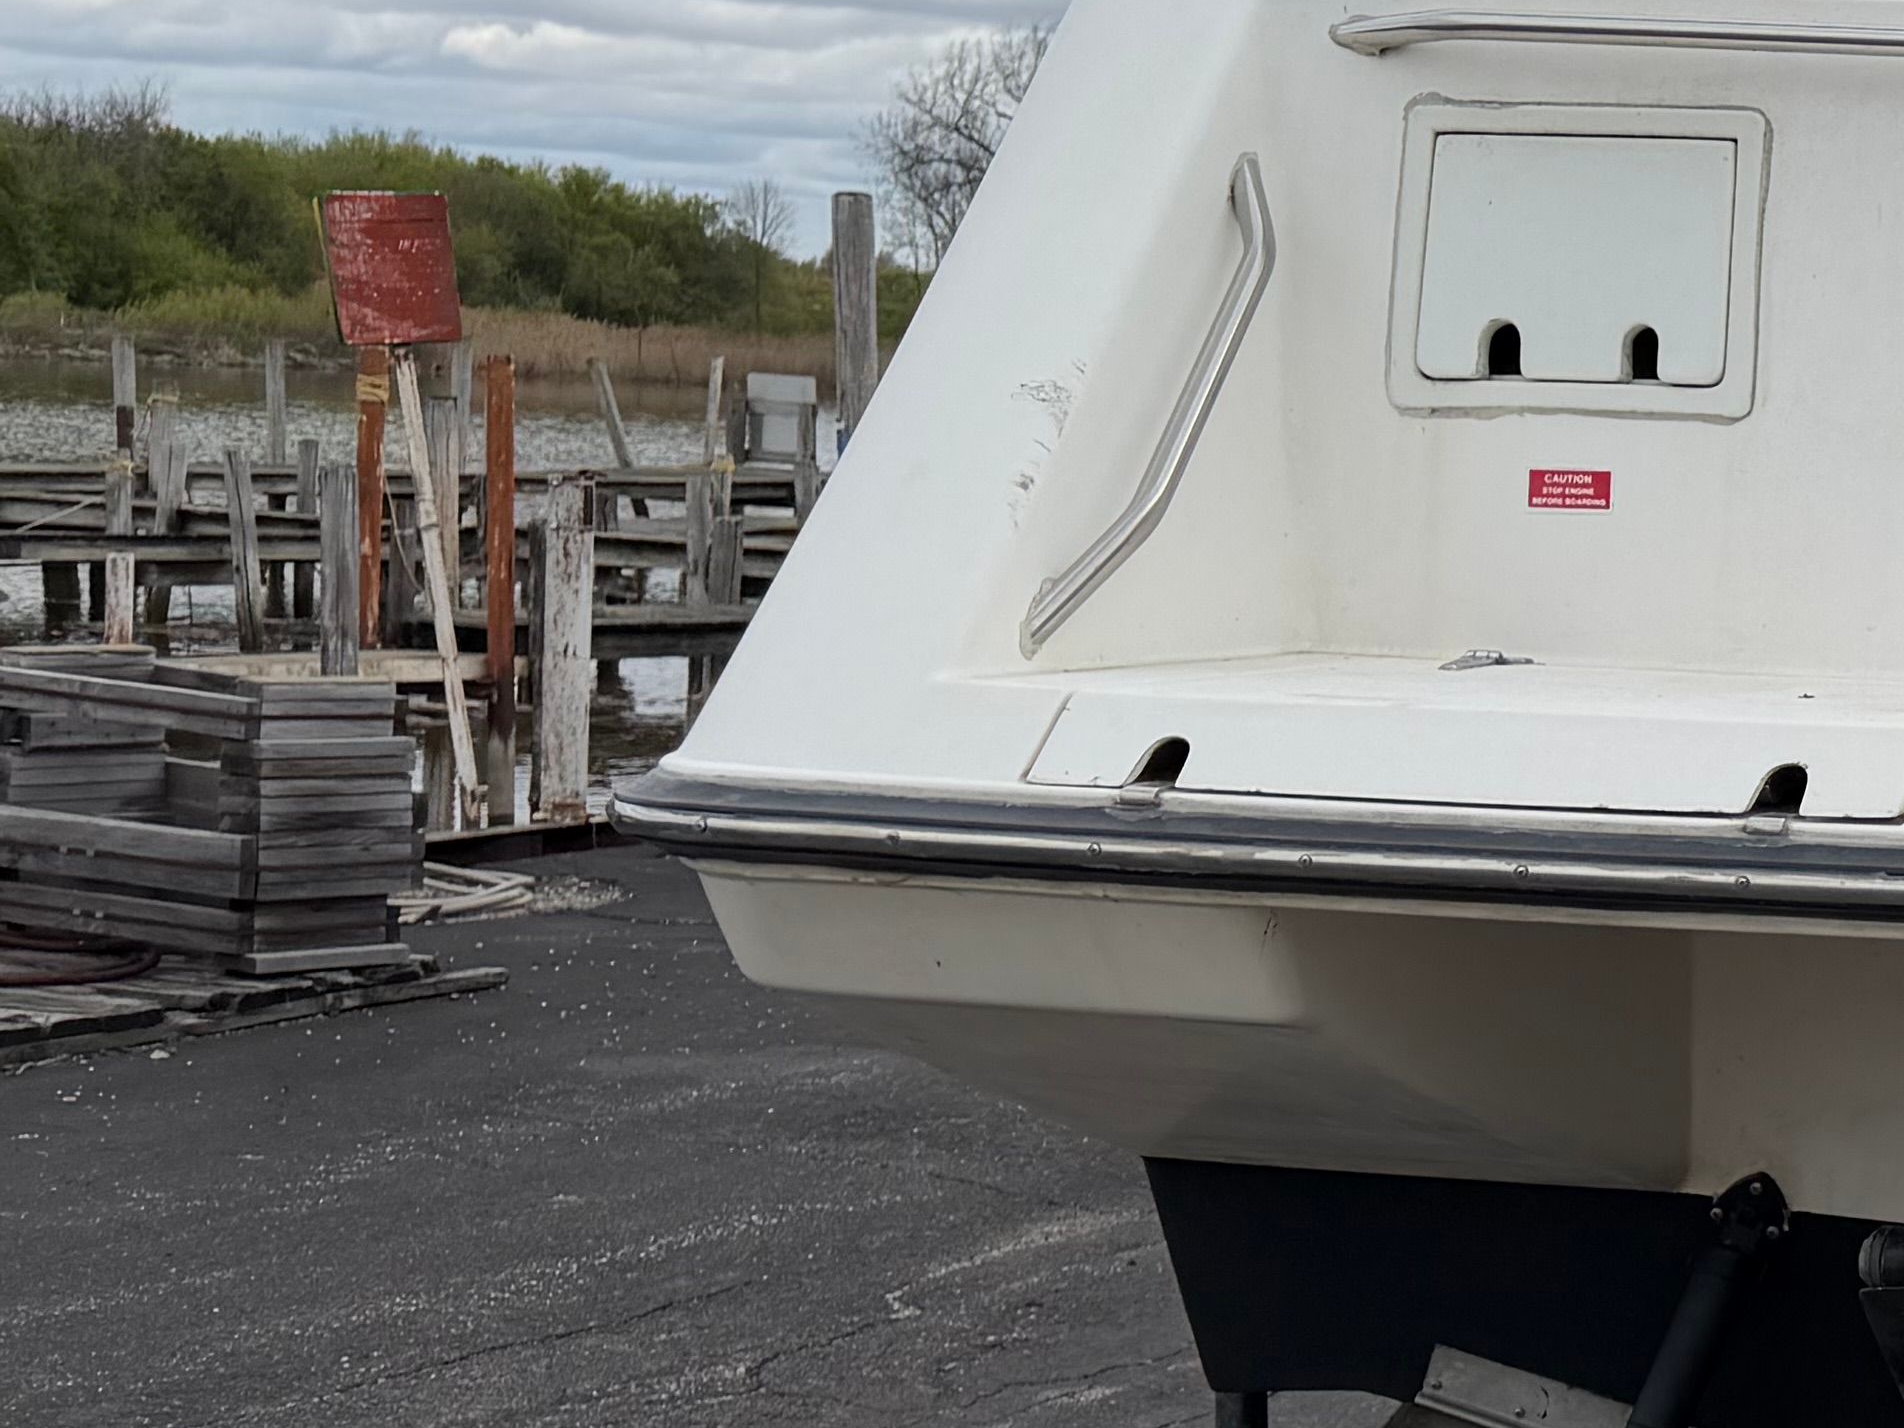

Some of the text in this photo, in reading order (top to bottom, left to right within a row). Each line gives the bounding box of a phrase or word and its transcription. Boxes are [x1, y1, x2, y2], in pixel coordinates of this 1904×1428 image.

[1544, 473, 1592, 484] CAUTION
[1542, 486, 1594, 495] STOP ENGINE
[1532, 496, 1607, 506] BEFORE BOARDING
